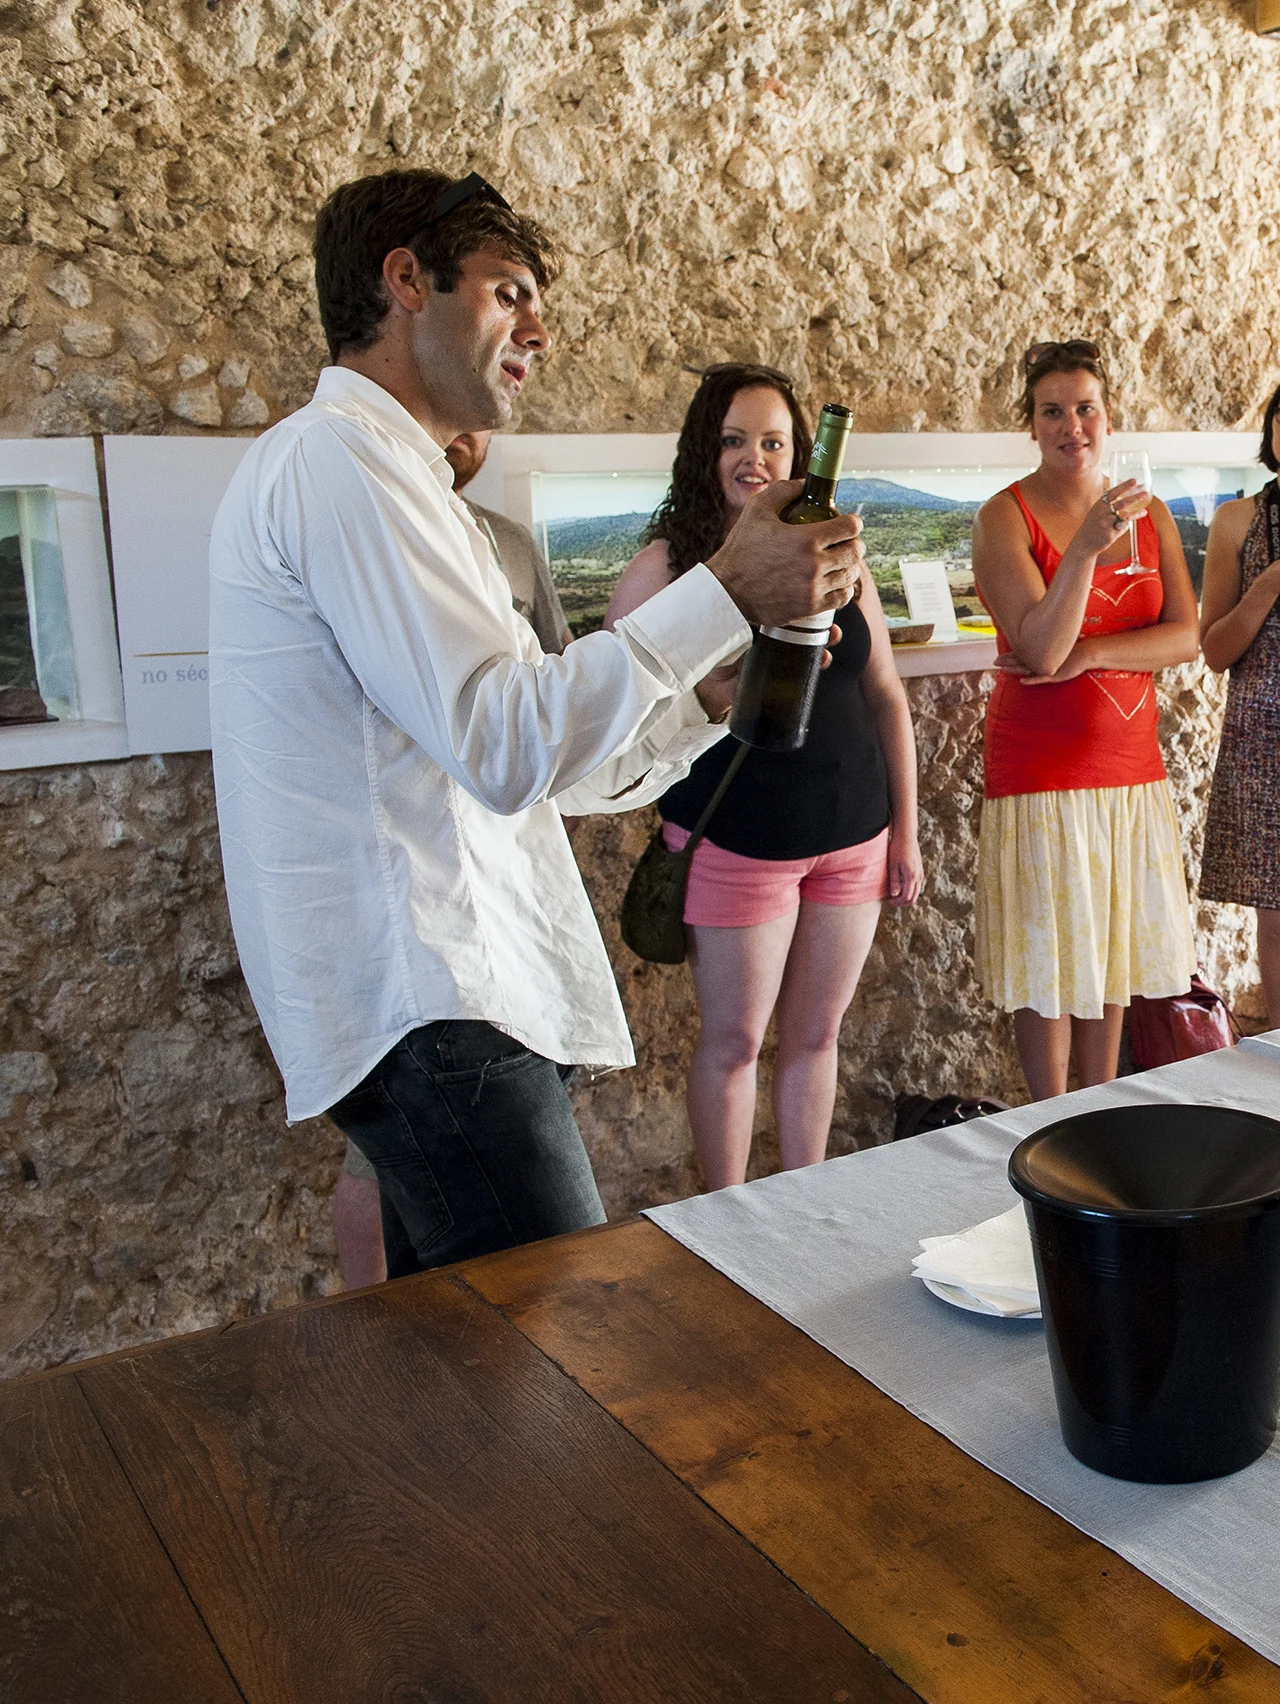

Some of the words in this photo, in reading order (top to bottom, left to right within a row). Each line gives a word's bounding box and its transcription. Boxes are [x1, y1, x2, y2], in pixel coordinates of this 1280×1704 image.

[1271, 526, 1280, 561] DIGITA
[141, 670, 167, 683] no
[176, 664, 208, 681] séc
